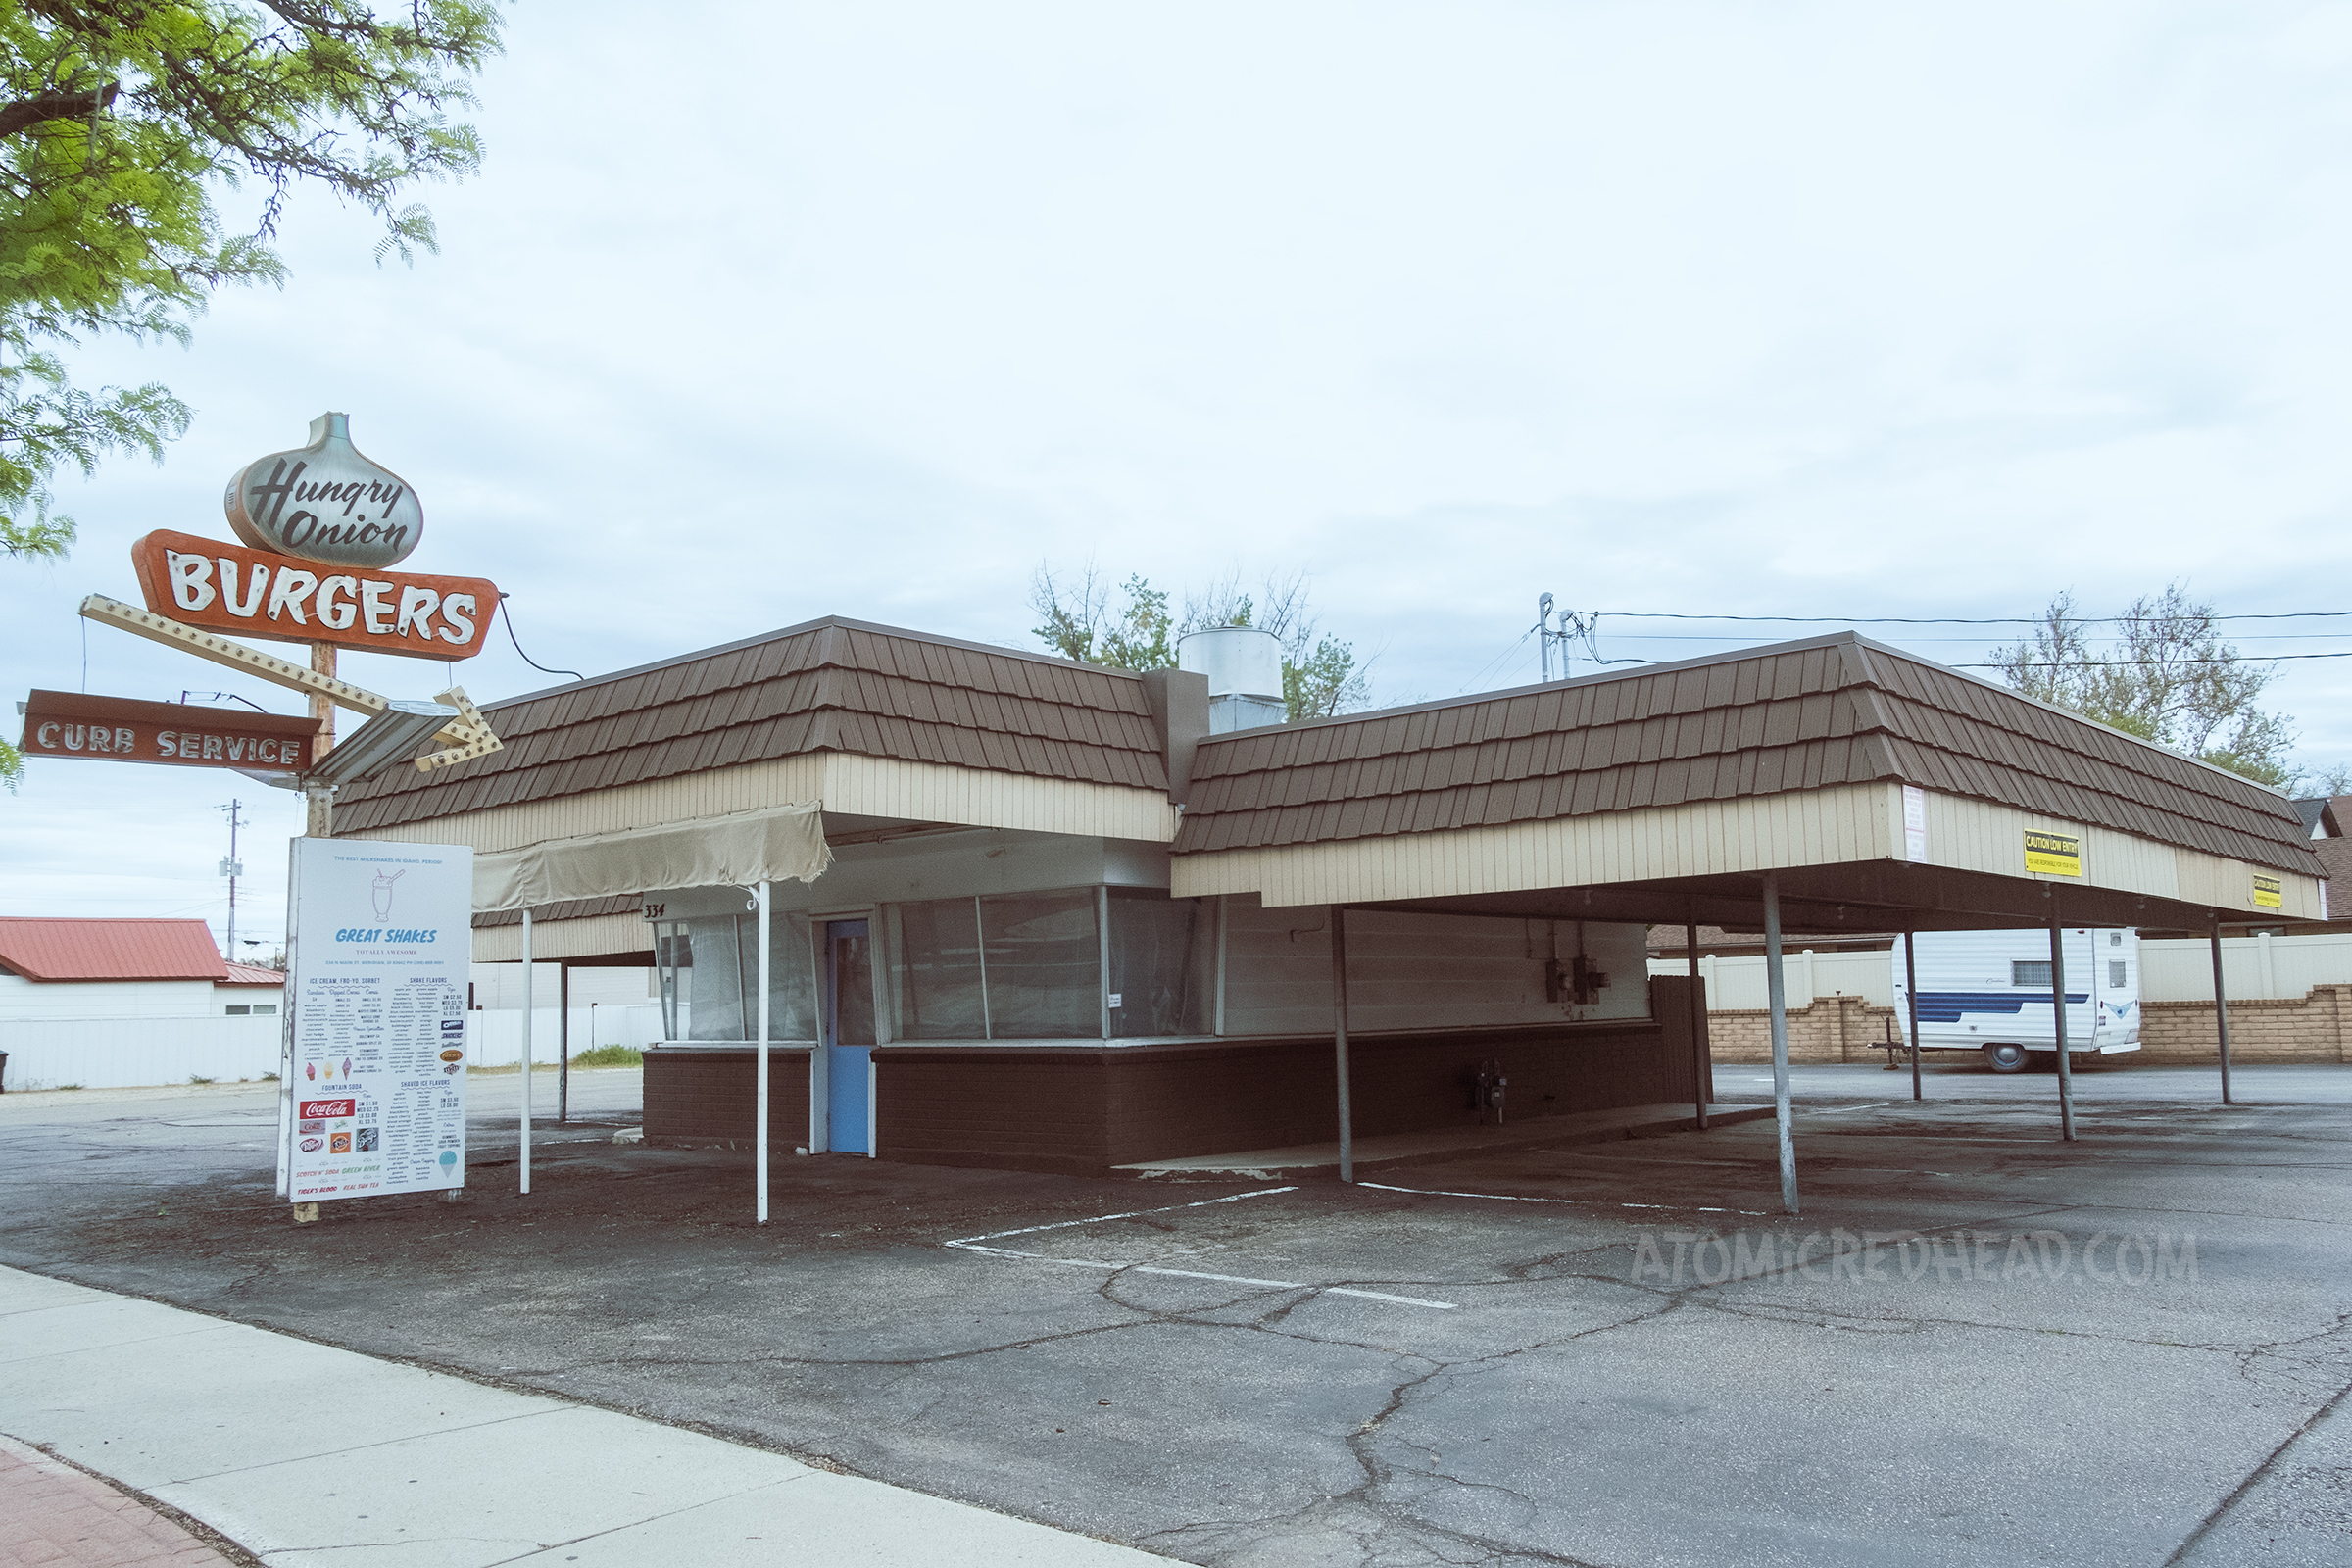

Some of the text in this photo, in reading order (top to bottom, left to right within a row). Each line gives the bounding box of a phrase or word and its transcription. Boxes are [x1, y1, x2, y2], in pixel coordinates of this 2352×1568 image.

[250, 457, 403, 525] Hungry
[281, 509, 408, 552] Onion
[166, 548, 477, 645] BURGERS
[37, 720, 301, 764] CURB SERVICE
[2027, 836, 2078, 853] CAUTION LOW ENTRY
[645, 904, 665, 918] 334
[336, 928, 438, 943] GREAT SHAKES
[306, 1101, 351, 1118] Coca-Cola
